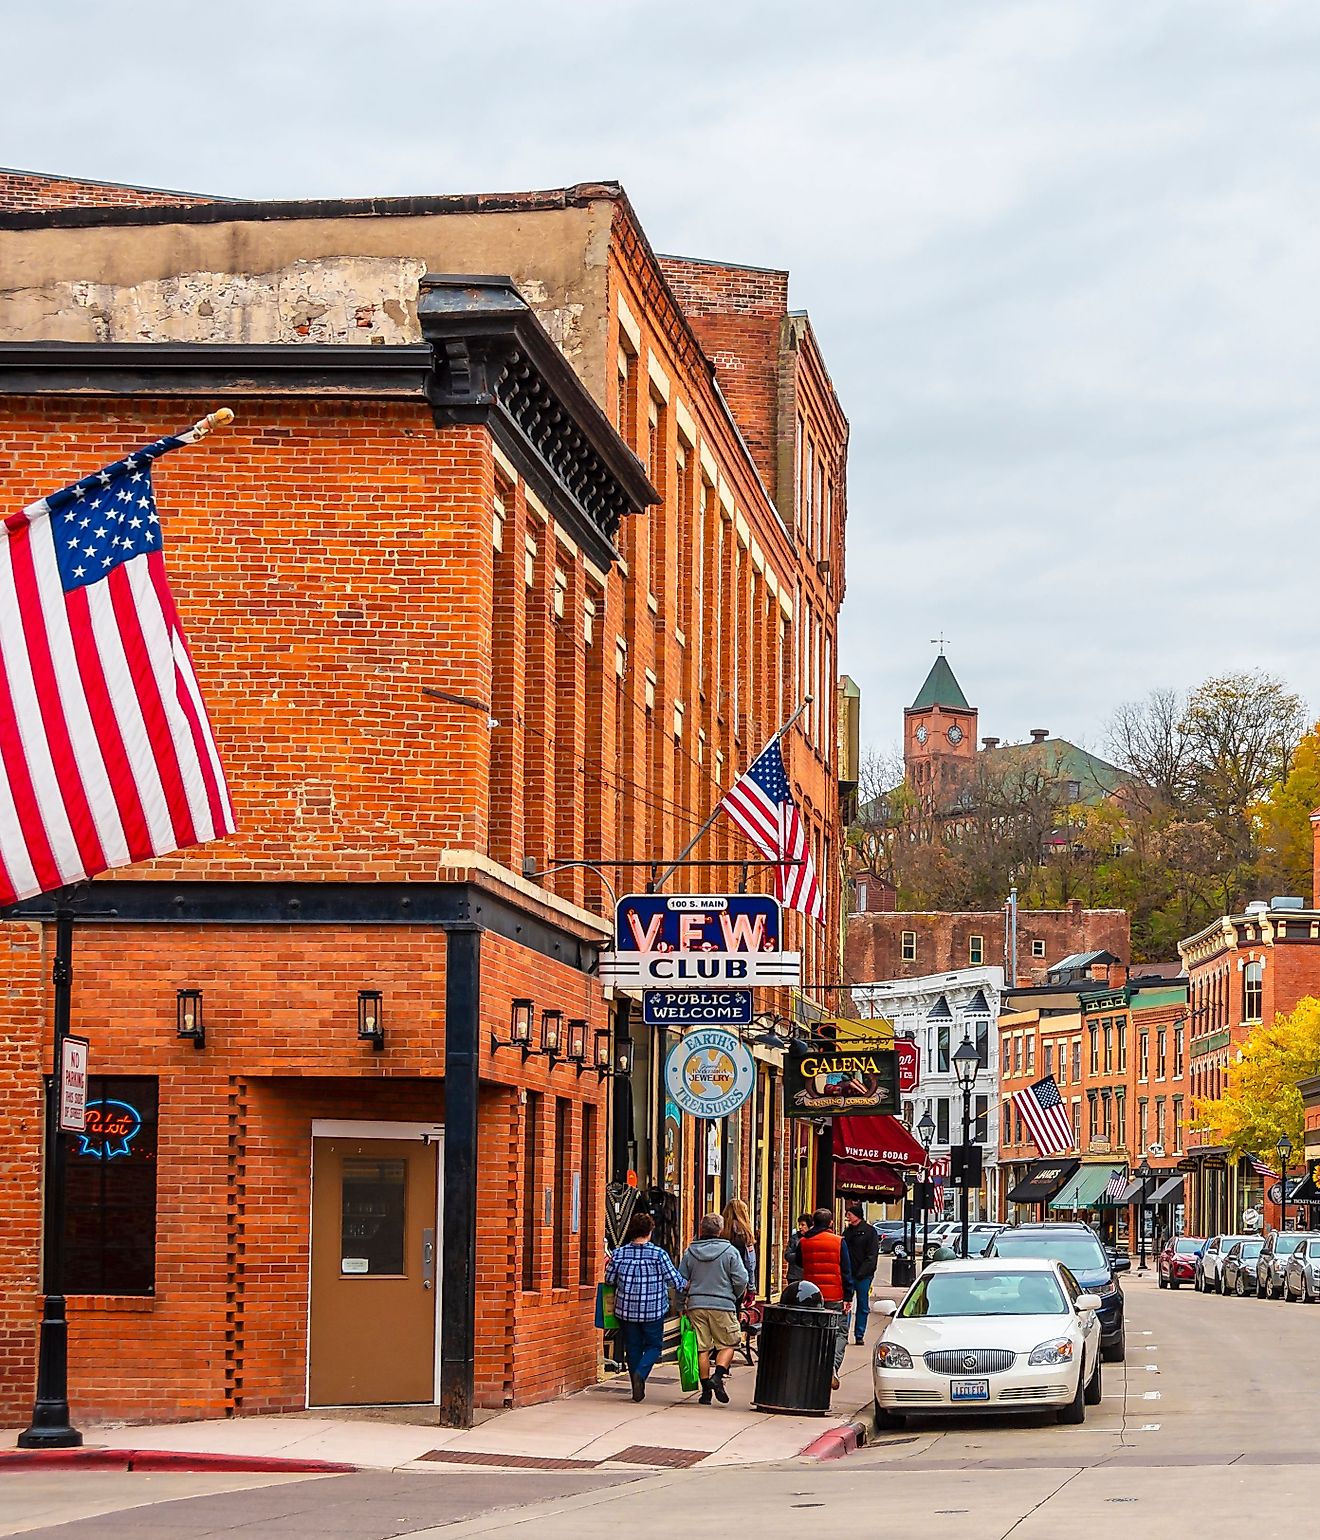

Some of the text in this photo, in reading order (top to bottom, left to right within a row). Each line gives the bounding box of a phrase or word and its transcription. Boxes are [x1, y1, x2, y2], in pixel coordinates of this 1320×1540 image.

[670, 900, 724, 908] 100 S. MAIN
[649, 958, 748, 979] CLUB
[664, 993, 731, 1005] PUBLIC
[652, 1007, 743, 1018] WELCOME
[685, 1033, 737, 1052] EARTH'S
[70, 1051, 80, 1068] NO
[800, 1056, 881, 1078] GALENA
[65, 1069, 85, 1089] PARKING
[688, 1074, 730, 1082] JEWELRY
[675, 1086, 744, 1115] TREASURES
[807, 1097, 878, 1107] CANNING COMPANY
[845, 1146, 909, 1160] VINTAGE SODAS
